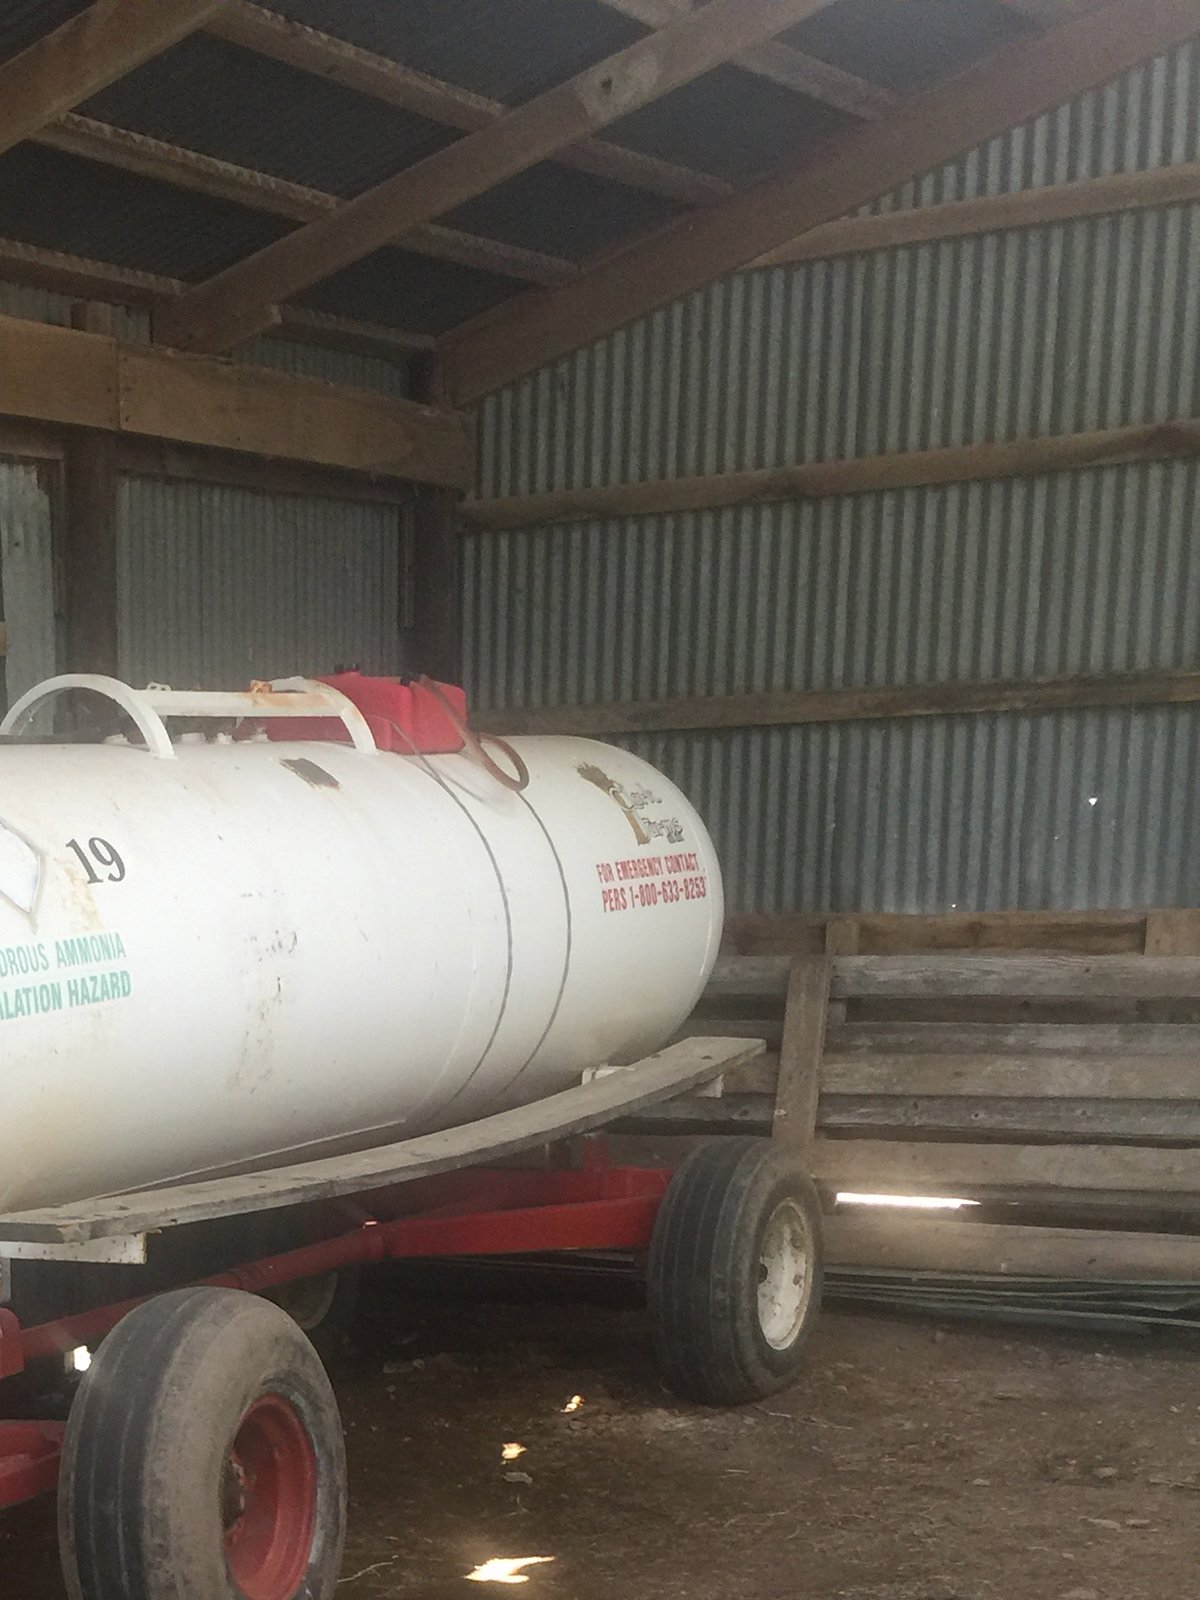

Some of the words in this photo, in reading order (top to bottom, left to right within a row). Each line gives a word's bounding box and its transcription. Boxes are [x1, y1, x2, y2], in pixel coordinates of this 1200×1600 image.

[66, 836, 126, 884] 19
[596, 863, 615, 884] FOR
[615, 856, 663, 881] EMERGENCY
[602, 887, 627, 913] PERS
[629, 876, 707, 908] 1-800-633-8253
[55, 932, 127, 968] AMMONIA
[67, 969, 132, 1008] HAZARD
